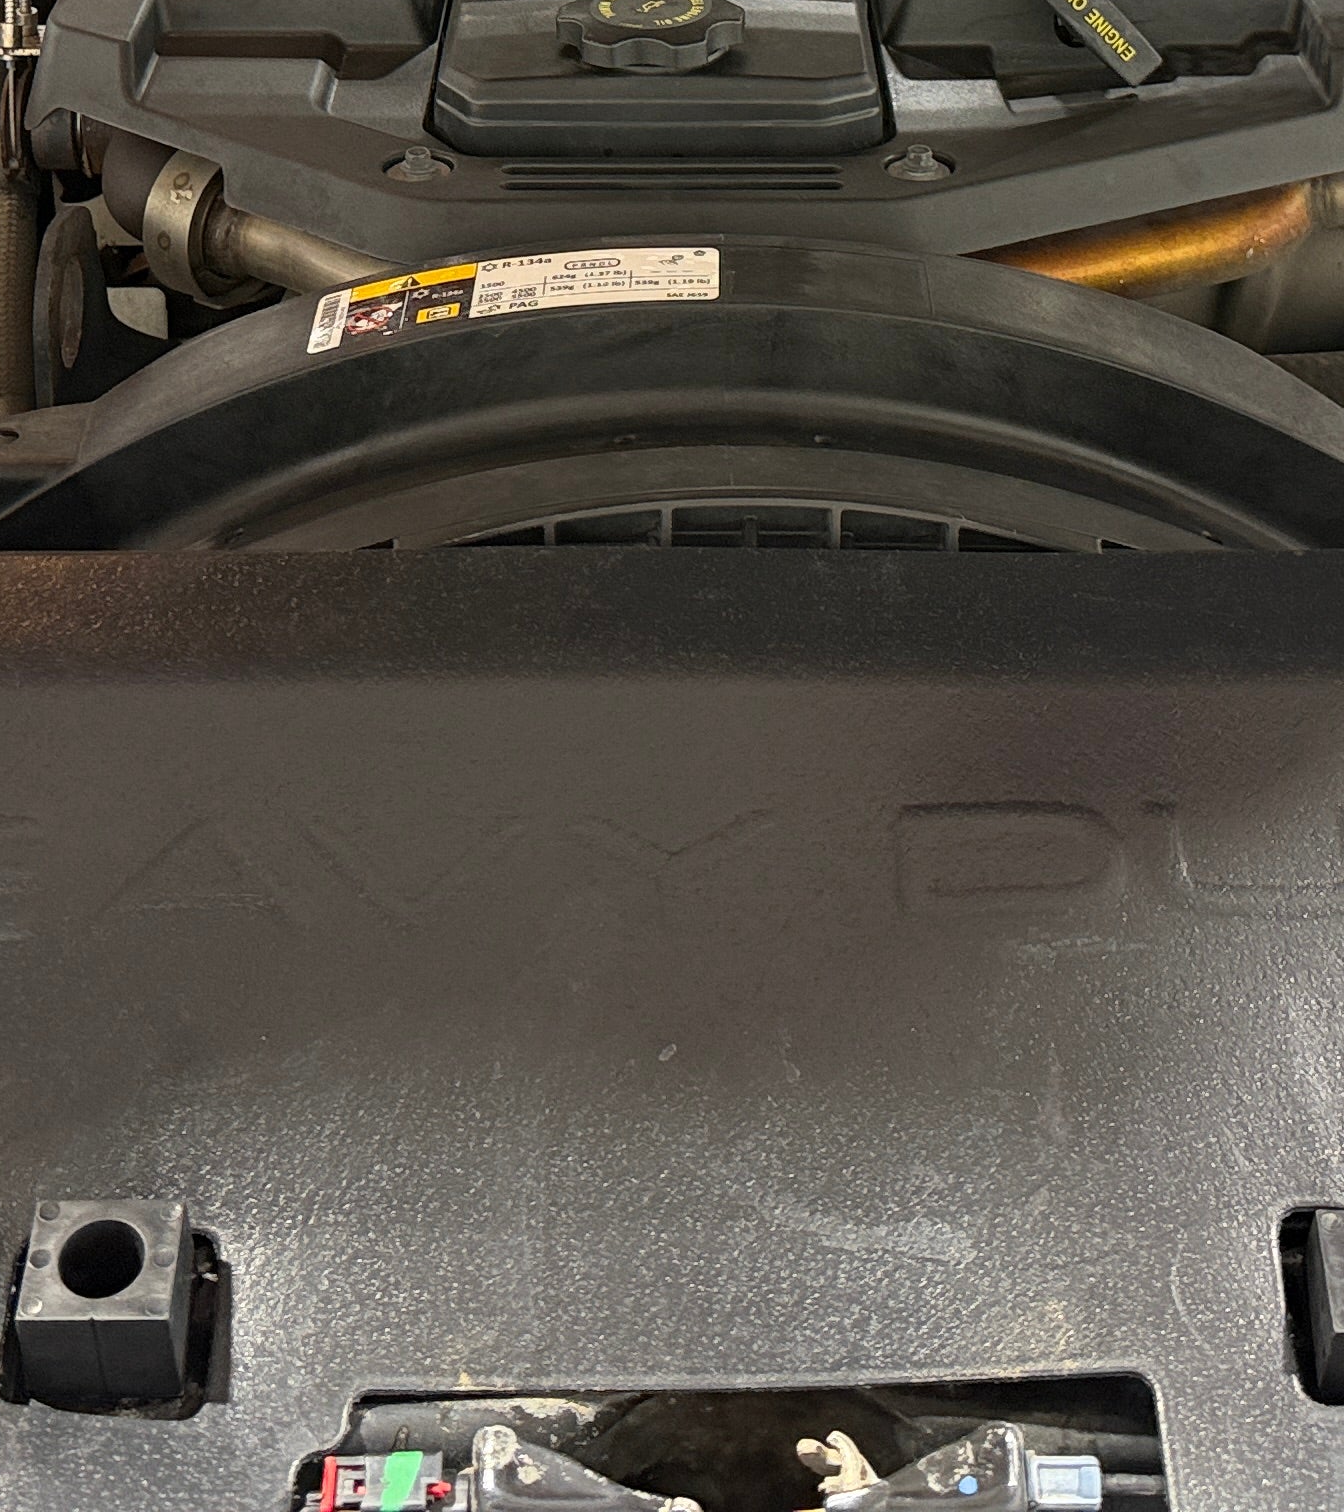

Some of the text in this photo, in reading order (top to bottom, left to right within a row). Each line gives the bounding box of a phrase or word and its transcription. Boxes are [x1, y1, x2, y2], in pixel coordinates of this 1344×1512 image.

[1084, 8, 1136, 62] ENGINE
[502, 257, 552, 269] R-134a
[509, 300, 539, 309] PAG
